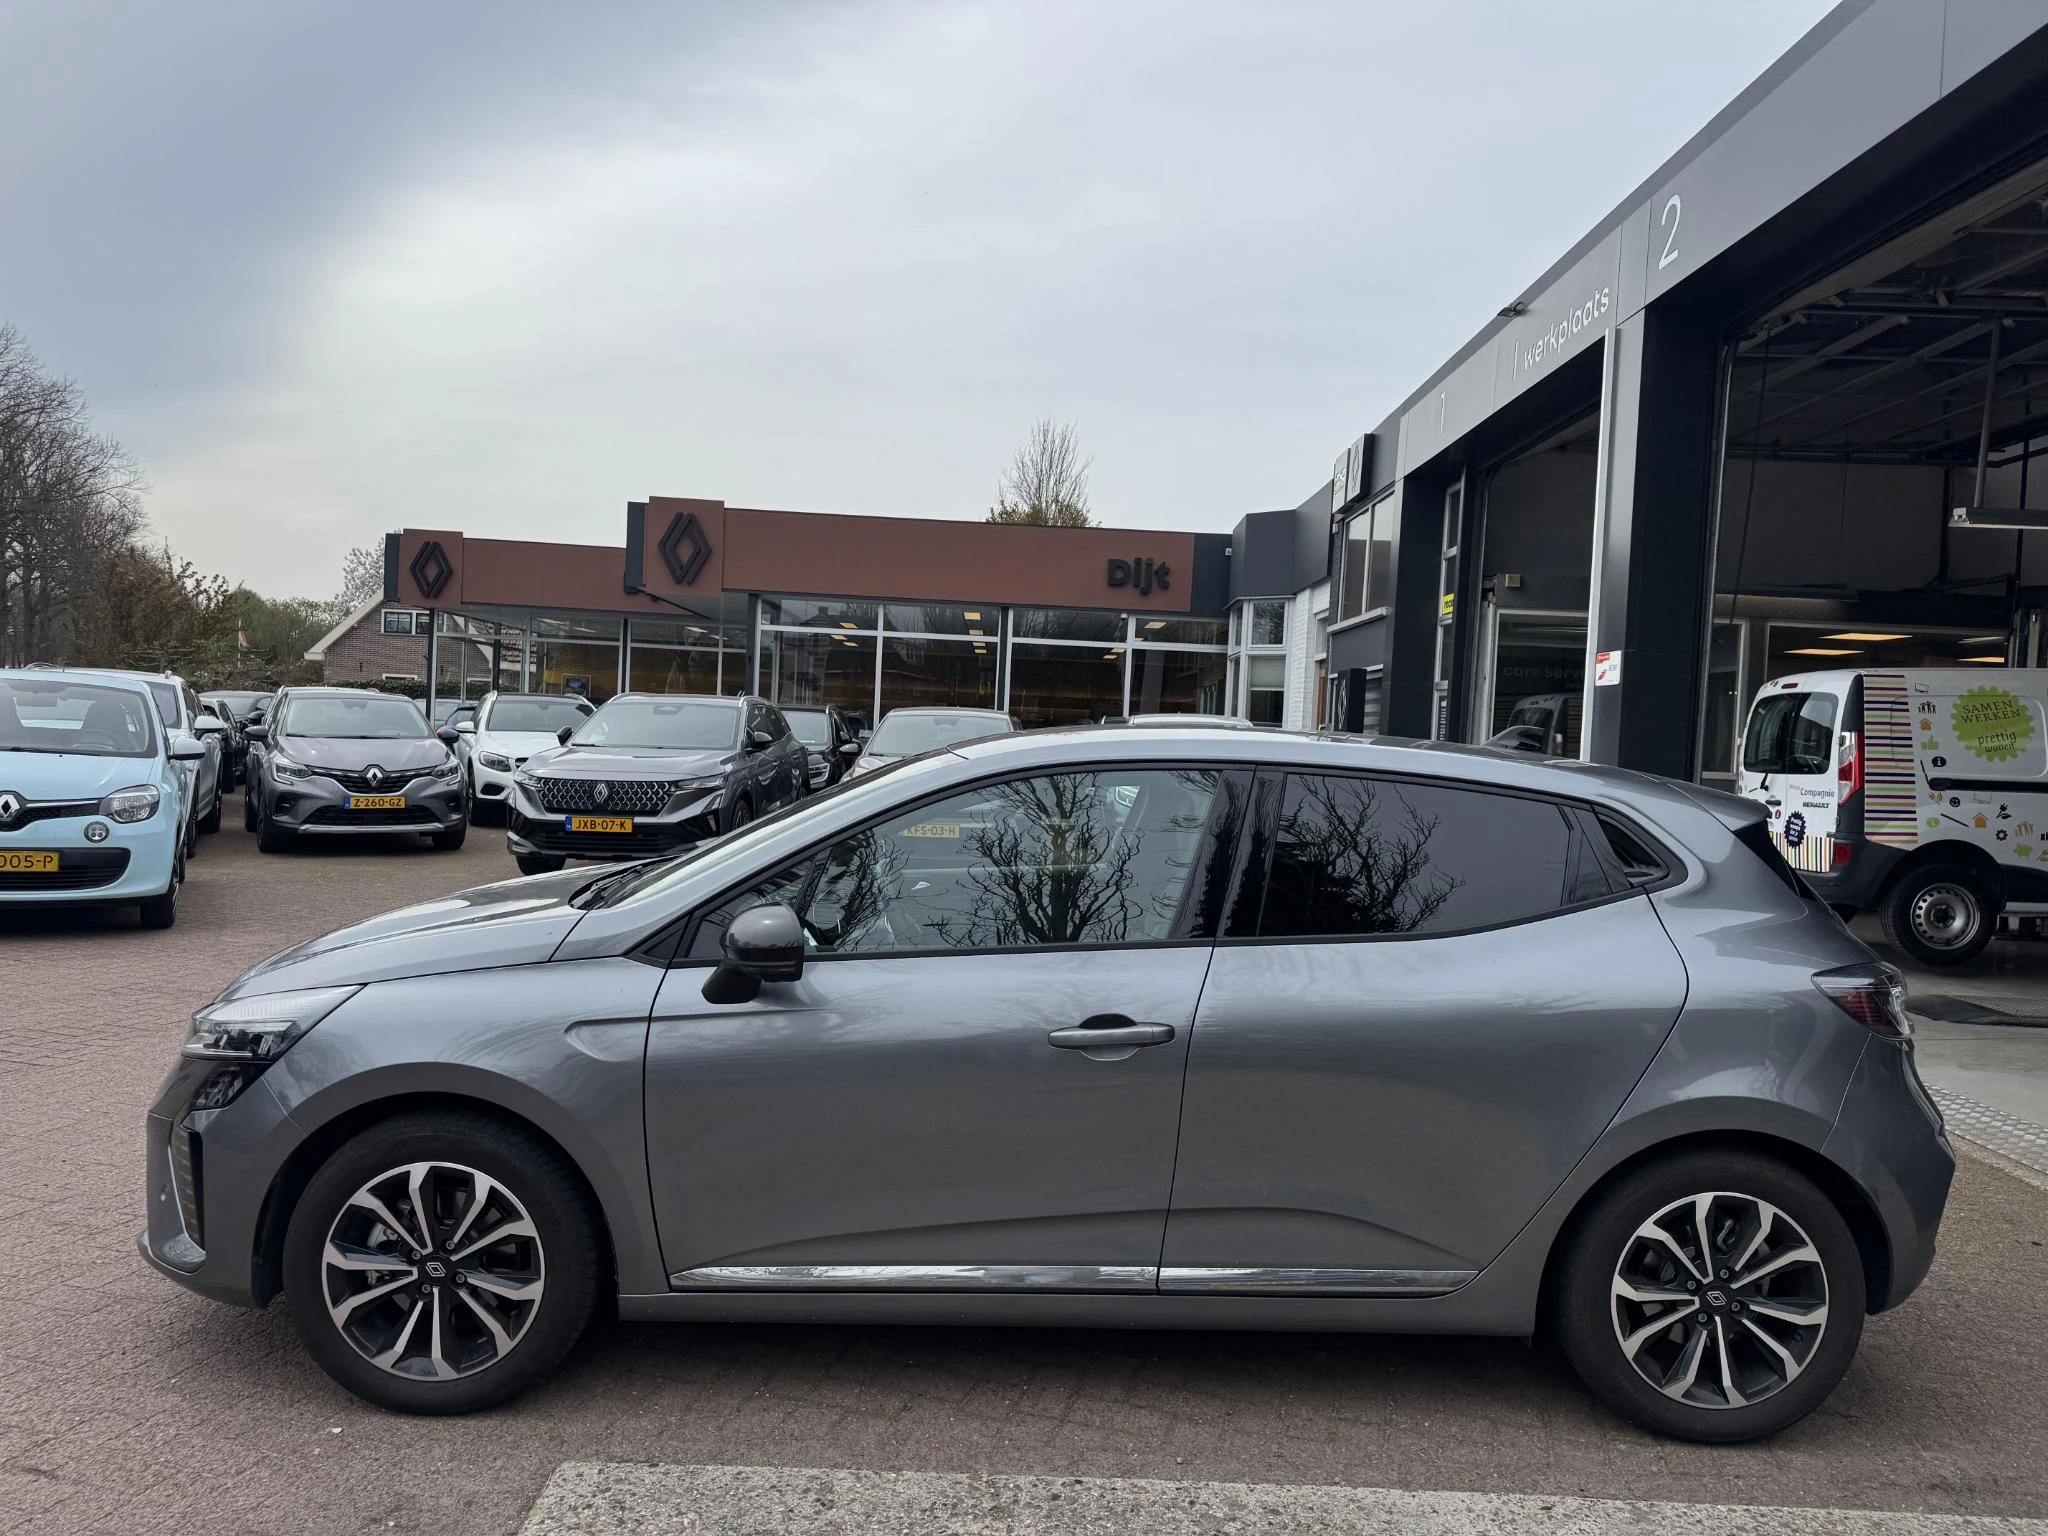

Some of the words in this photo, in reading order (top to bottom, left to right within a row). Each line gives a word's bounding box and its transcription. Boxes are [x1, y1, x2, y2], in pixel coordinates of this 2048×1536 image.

[1658, 194, 1681, 270] 2
[1524, 286, 1610, 371] werkplaats
[1440, 391, 1446, 436] 1
[1107, 557, 1170, 596] Dijt
[1962, 699, 2014, 715] SAMEN
[1961, 708, 2020, 724] WERKEN
[1977, 729, 2017, 748] prettig
[1985, 743, 2016, 753] wonen
[1800, 787, 1835, 798] Compagnie
[354, 798, 402, 808] Z-260-GZ
[1802, 801, 1831, 809] RENAULT
[575, 819, 627, 831] JXB-07-K
